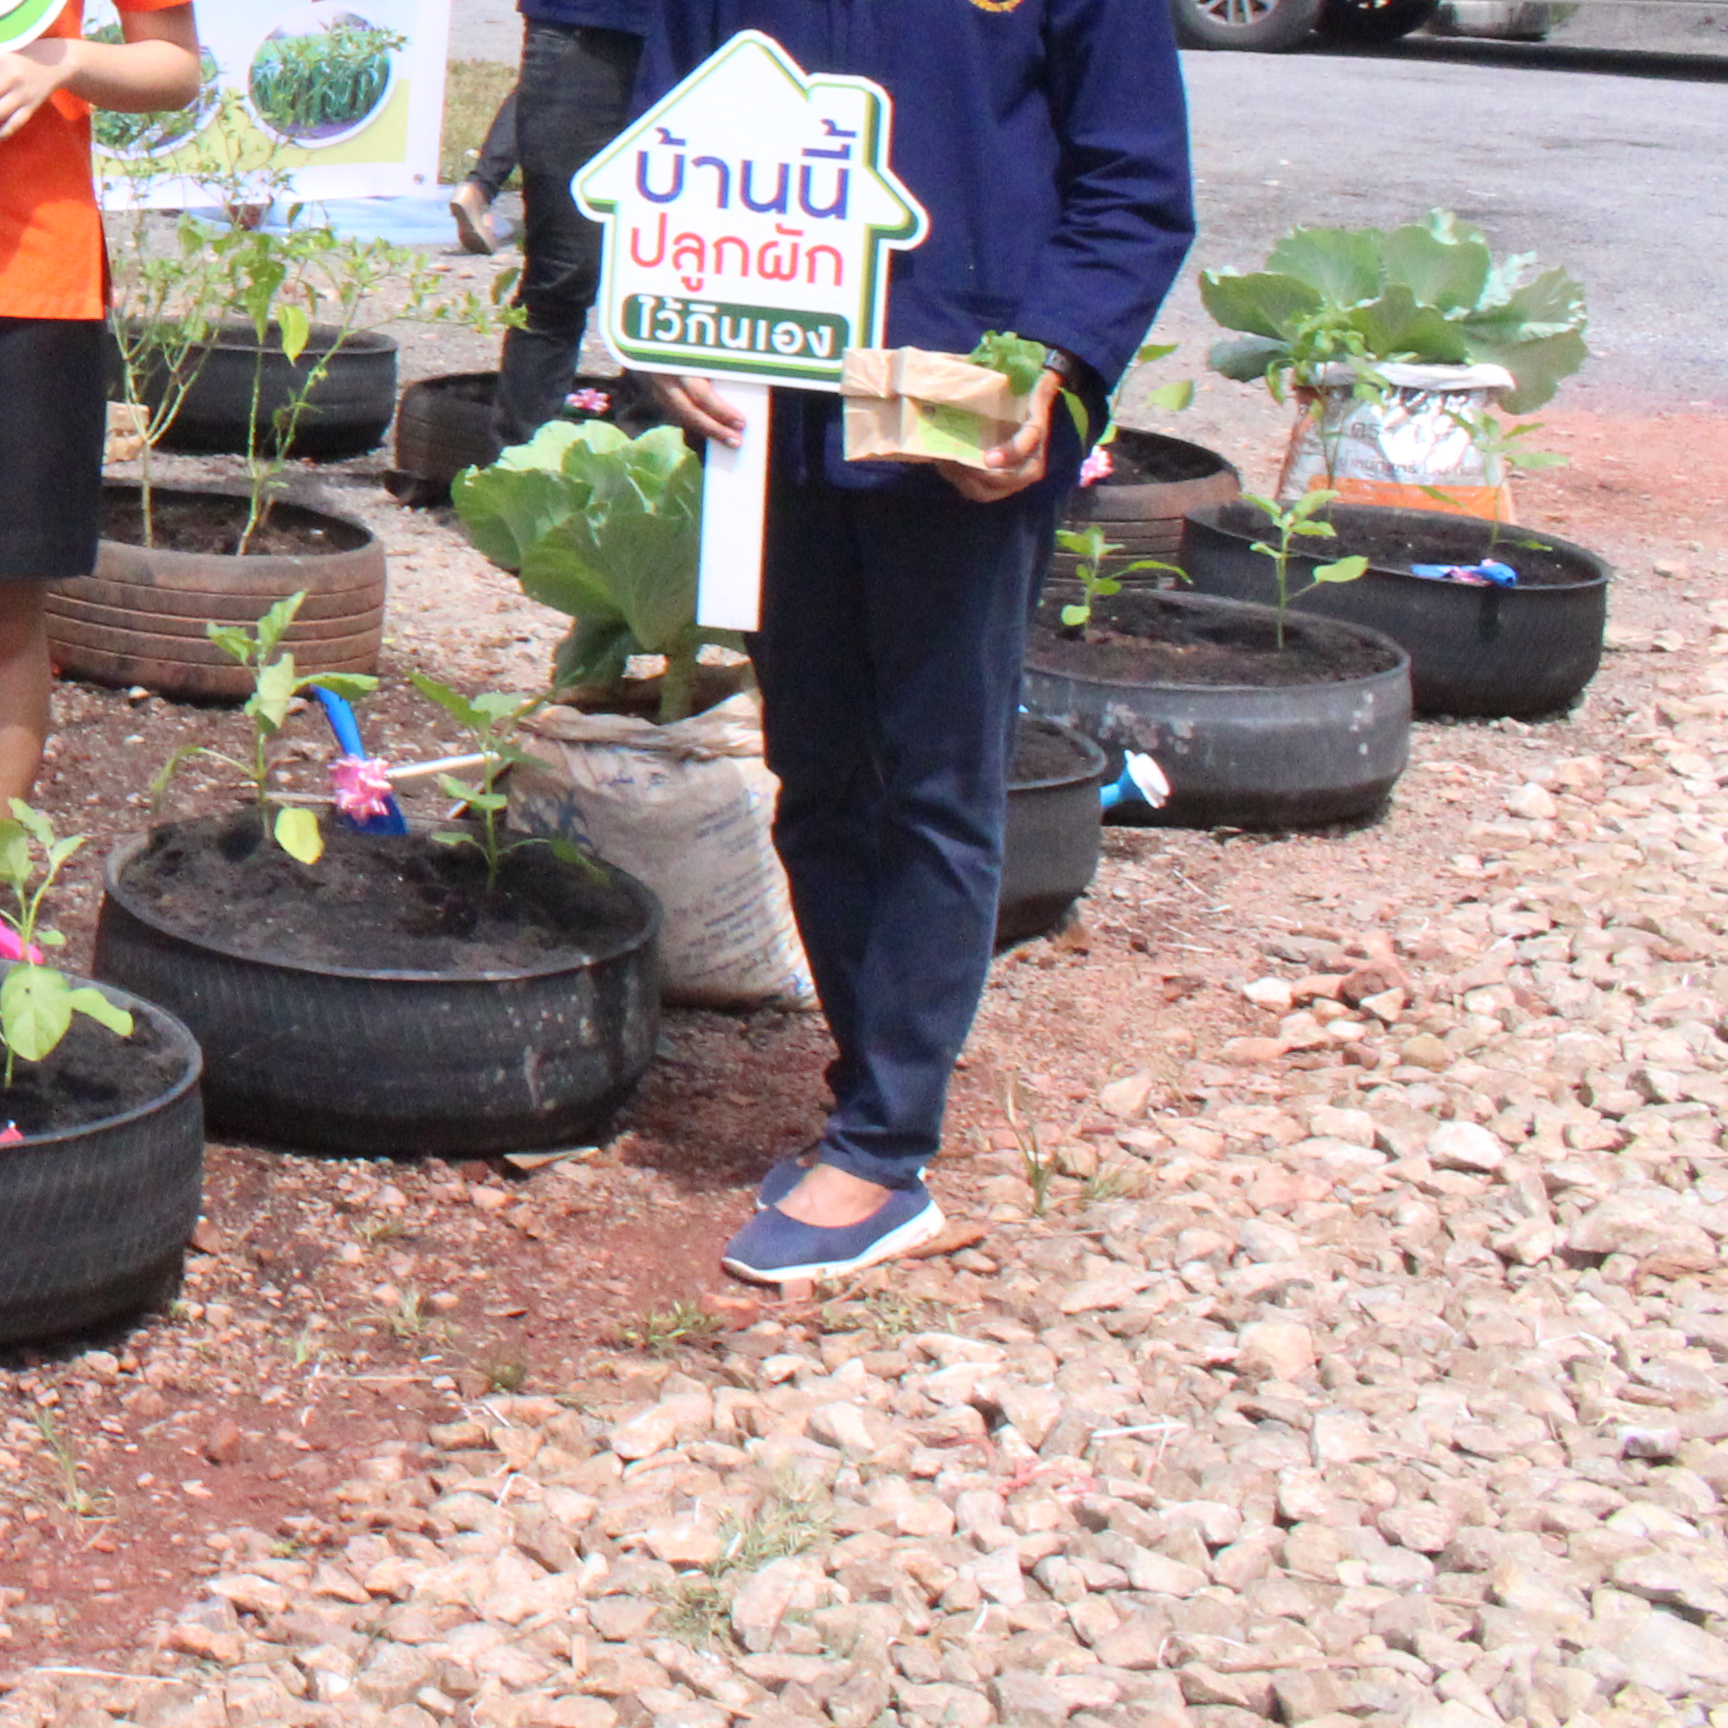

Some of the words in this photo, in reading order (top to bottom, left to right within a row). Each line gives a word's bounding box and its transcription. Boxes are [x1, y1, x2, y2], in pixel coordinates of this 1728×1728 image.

[636, 118, 857, 220] บ้านนี้
[630, 212, 843, 293] ปลูกผัก
[637, 295, 834, 358] ไว้กินเอง
